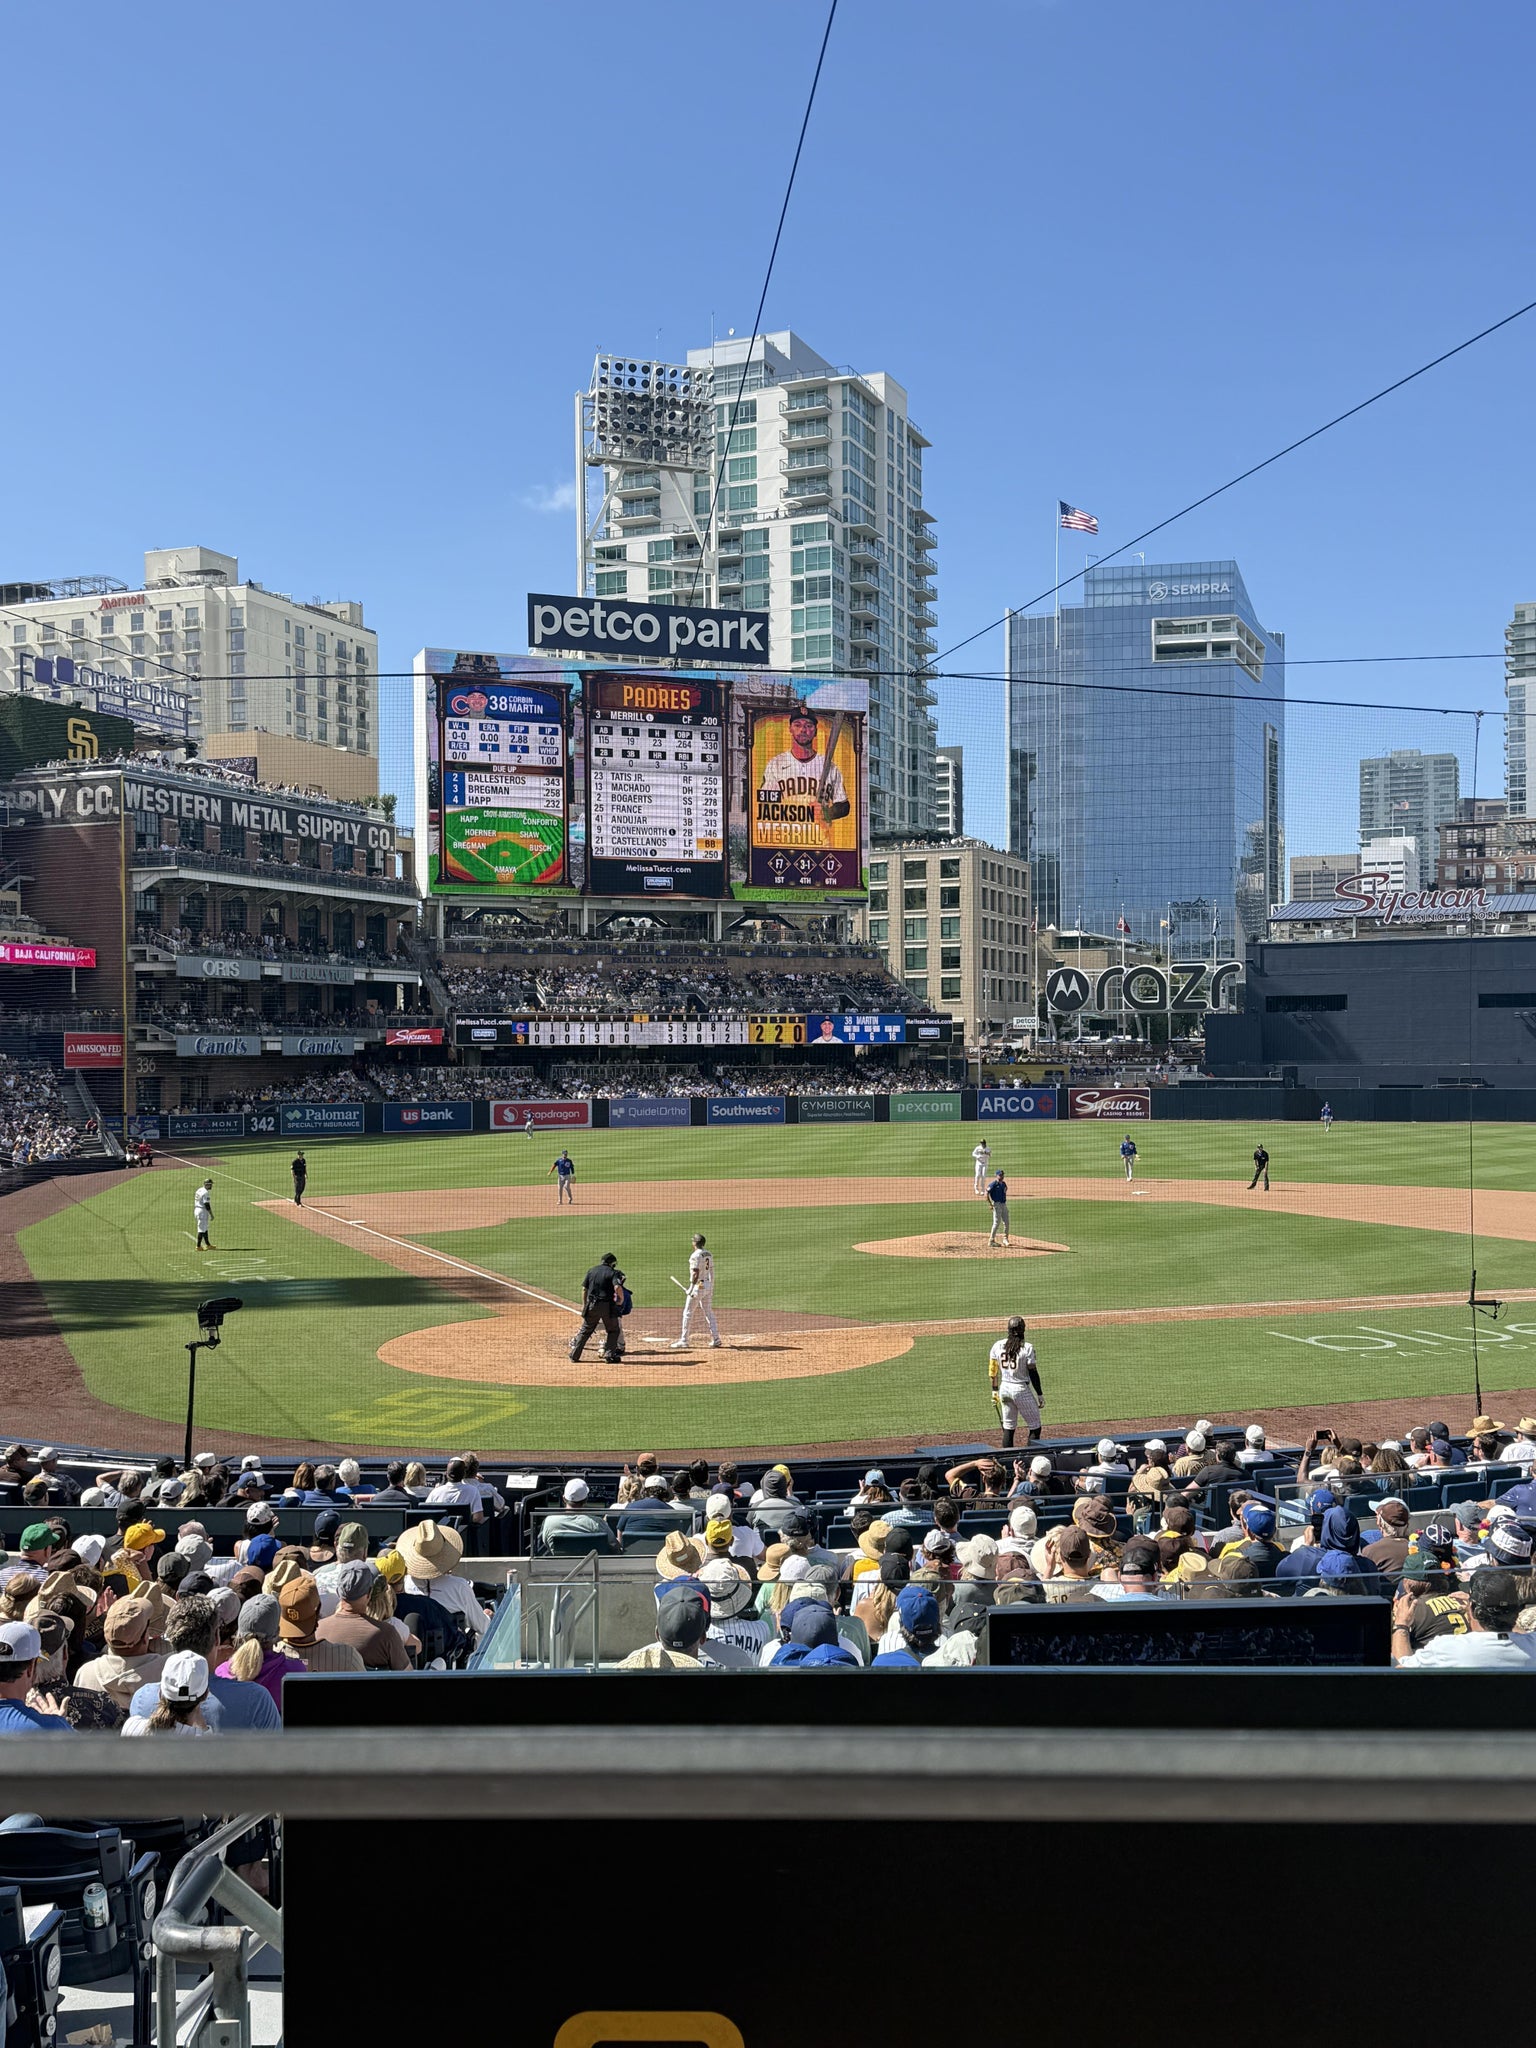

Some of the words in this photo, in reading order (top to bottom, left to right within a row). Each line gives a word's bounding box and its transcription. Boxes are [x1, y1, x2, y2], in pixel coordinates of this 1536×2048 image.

[1172, 582, 1230, 595] SEMPRA
[98, 594, 144, 610] Marriott
[534, 602, 660, 644] petco
[669, 615, 764, 654] park
[489, 696, 508, 711] 38
[623, 685, 690, 710] PADRES
[509, 704, 543, 714] MARTIN
[610, 711, 645, 721] MERRILL
[682, 716, 692, 724] CF
[701, 717, 717, 725] .200
[452, 732, 466, 740] 0-0
[481, 733, 498, 742] 0.00
[510, 735, 528, 744] 2.88
[543, 737, 554, 746] 4.0
[452, 752, 466, 760] 0/0
[541, 756, 557, 765] 1.00
[468, 774, 526, 785] BALLESTEROS
[543, 778, 560, 786] .343
[611, 772, 632, 781] TATIS
[453, 784, 458, 793] 3
[468, 785, 510, 795] BREGMAN
[543, 789, 560, 797] .258
[611, 784, 650, 793] MACHADO
[77, 785, 120, 816] CO.
[453, 796, 458, 804] 4
[468, 796, 491, 805] HAPP
[544, 800, 560, 808] .232
[612, 794, 652, 803] BOGAERTS
[760, 792, 764, 800] 3
[770, 792, 779, 801] CF
[483, 810, 526, 818] CROW-ARMSTRONG
[612, 805, 642, 813] FRANCE
[757, 804, 814, 822] JACKSON
[124, 782, 222, 823] WESTERN
[232, 802, 292, 834] METAL
[298, 814, 361, 846] SUPPLY
[368, 826, 394, 852] CO.
[523, 818, 558, 826] CONFORTO
[611, 816, 647, 824] ANDUJAR
[612, 827, 667, 836] CRONENWORTH
[757, 822, 822, 845] MERRILL
[612, 837, 667, 846] CASTELLANOS
[612, 848, 648, 856] JOHNSON
[626, 865, 691, 873] MelissaTucci.com
[775, 858, 783, 869] F7
[801, 859, 810, 869] 3-1
[1333, 872, 1493, 924] Sycuan
[1401, 914, 1444, 922] CASINO
[1457, 911, 1500, 921] RESORT
[15, 949, 32, 959] BAJA
[35, 950, 75, 961] CALIFORNIA
[202, 960, 240, 977] ORIS
[1096, 962, 1242, 1012] razr
[845, 1016, 852, 1025] 38
[856, 1016, 878, 1025] MARTIN
[396, 1030, 431, 1044] Sycuan
[756, 1025, 764, 1042] 2
[775, 1025, 783, 1042] 2
[793, 1025, 802, 1042] 0
[76, 1045, 107, 1053] MISSION
[195, 1037, 248, 1056] Canel's
[298, 1037, 343, 1055] Canel's
[137, 1057, 155, 1073] 336
[802, 1101, 871, 1110] CYMBIOTIKA
[980, 1097, 1034, 1112] ARCO
[1076, 1092, 1141, 1116] Sycuan
[306, 1108, 359, 1121] Palomar
[404, 1111, 419, 1121] us
[421, 1109, 452, 1121] bank
[523, 1109, 580, 1120] Sapdragon
[629, 1106, 687, 1117] QuidelOrtho
[712, 1105, 772, 1116] Southwest
[251, 1117, 274, 1132] 342
[706, 1258, 710, 1270] 3
[1265, 1322, 1536, 1351] blue
